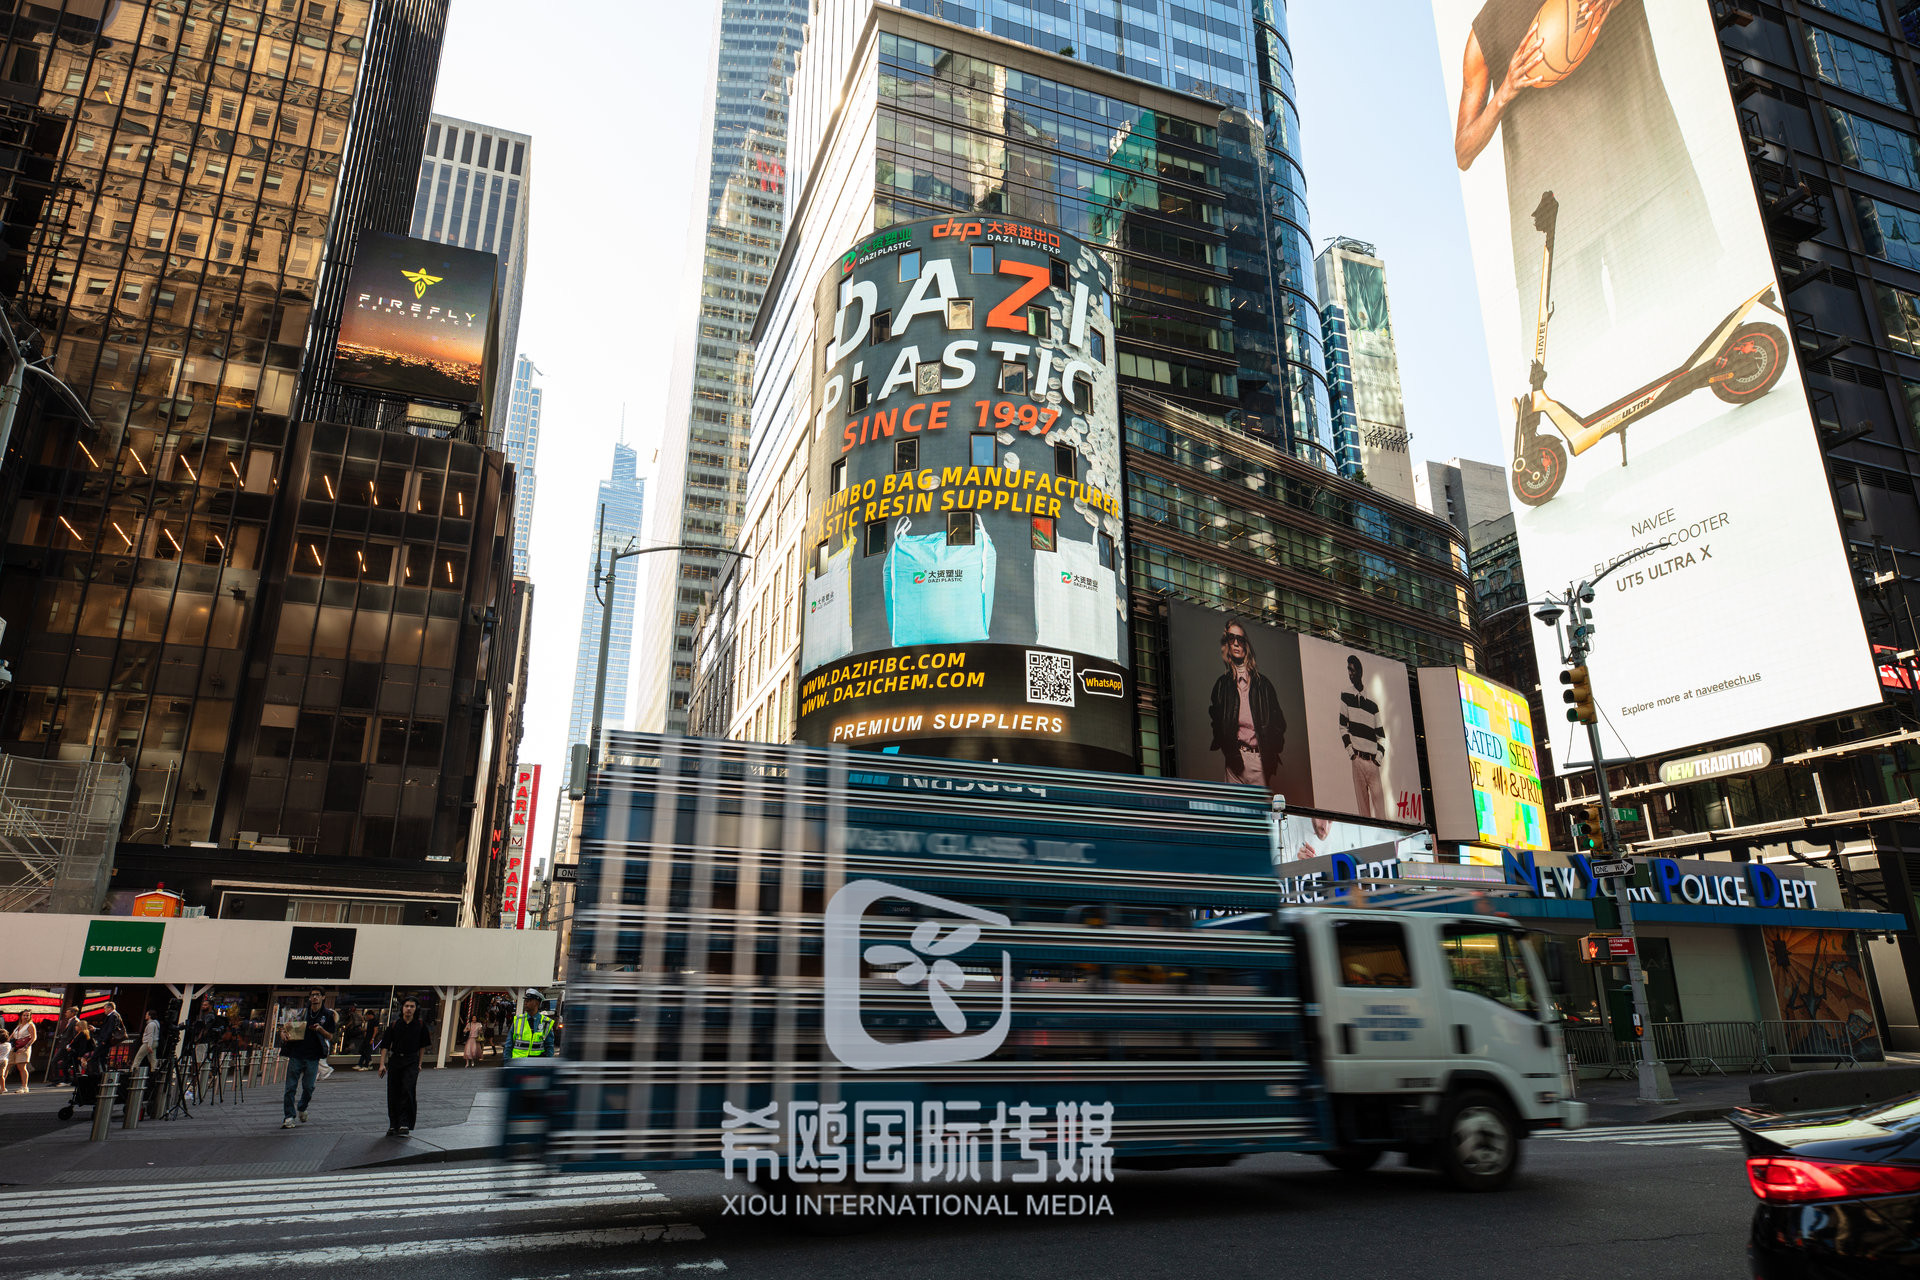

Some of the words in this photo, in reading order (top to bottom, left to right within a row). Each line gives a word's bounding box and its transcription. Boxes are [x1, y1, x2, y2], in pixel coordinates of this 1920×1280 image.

[860, 228, 912, 257] 大资塑业
[932, 217, 982, 242] dzp
[987, 221, 1060, 248] 大资进出口
[987, 234, 1013, 243] DAZI
[1018, 238, 1061, 255] IMP/EXP
[859, 251, 877, 265] DAZI
[877, 240, 912, 257] PLASTIC
[358, 293, 476, 321] FIREFLY
[358, 303, 472, 328] AEROSPACE
[833, 258, 1089, 366] DAZI
[1537, 321, 1546, 356] NAVEE
[842, 401, 951, 453] SINCE
[974, 400, 1059, 435] 1997
[821, 478, 876, 523] JUMBO
[883, 468, 933, 495] BAG
[941, 466, 1119, 519] MANUFACTURER
[864, 491, 934, 522] RESIN
[940, 489, 1061, 519] SUPPLIER
[1631, 507, 1677, 537] NAVEE
[1659, 511, 1730, 550] SCOOTER
[1616, 571, 1644, 592] UT5
[1648, 552, 1697, 580] ULTRA
[1700, 544, 1713, 561] X
[802, 652, 966, 700] WWW.DAZIFIBC.COM
[1085, 677, 1122, 691] WhatsApp
[1621, 701, 1655, 717] Explore
[1656, 693, 1681, 707] more
[1683, 689, 1693, 700] at
[1695, 672, 1762, 697] naveetech.us
[833, 715, 923, 742] PREMIUM
[933, 713, 1063, 734] SUPPLIERS
[513, 772, 531, 825] PARK
[1397, 791, 1422, 822] H&M
[1331, 853, 1397, 898] DEPT
[1595, 865, 1609, 873] ONE
[1615, 863, 1628, 871] WAY
[1657, 858, 1750, 907] POLICE
[1751, 864, 1818, 909] DEPT
[503, 857, 521, 912] PARK
[90, 945, 142, 953] STARBUCKS
